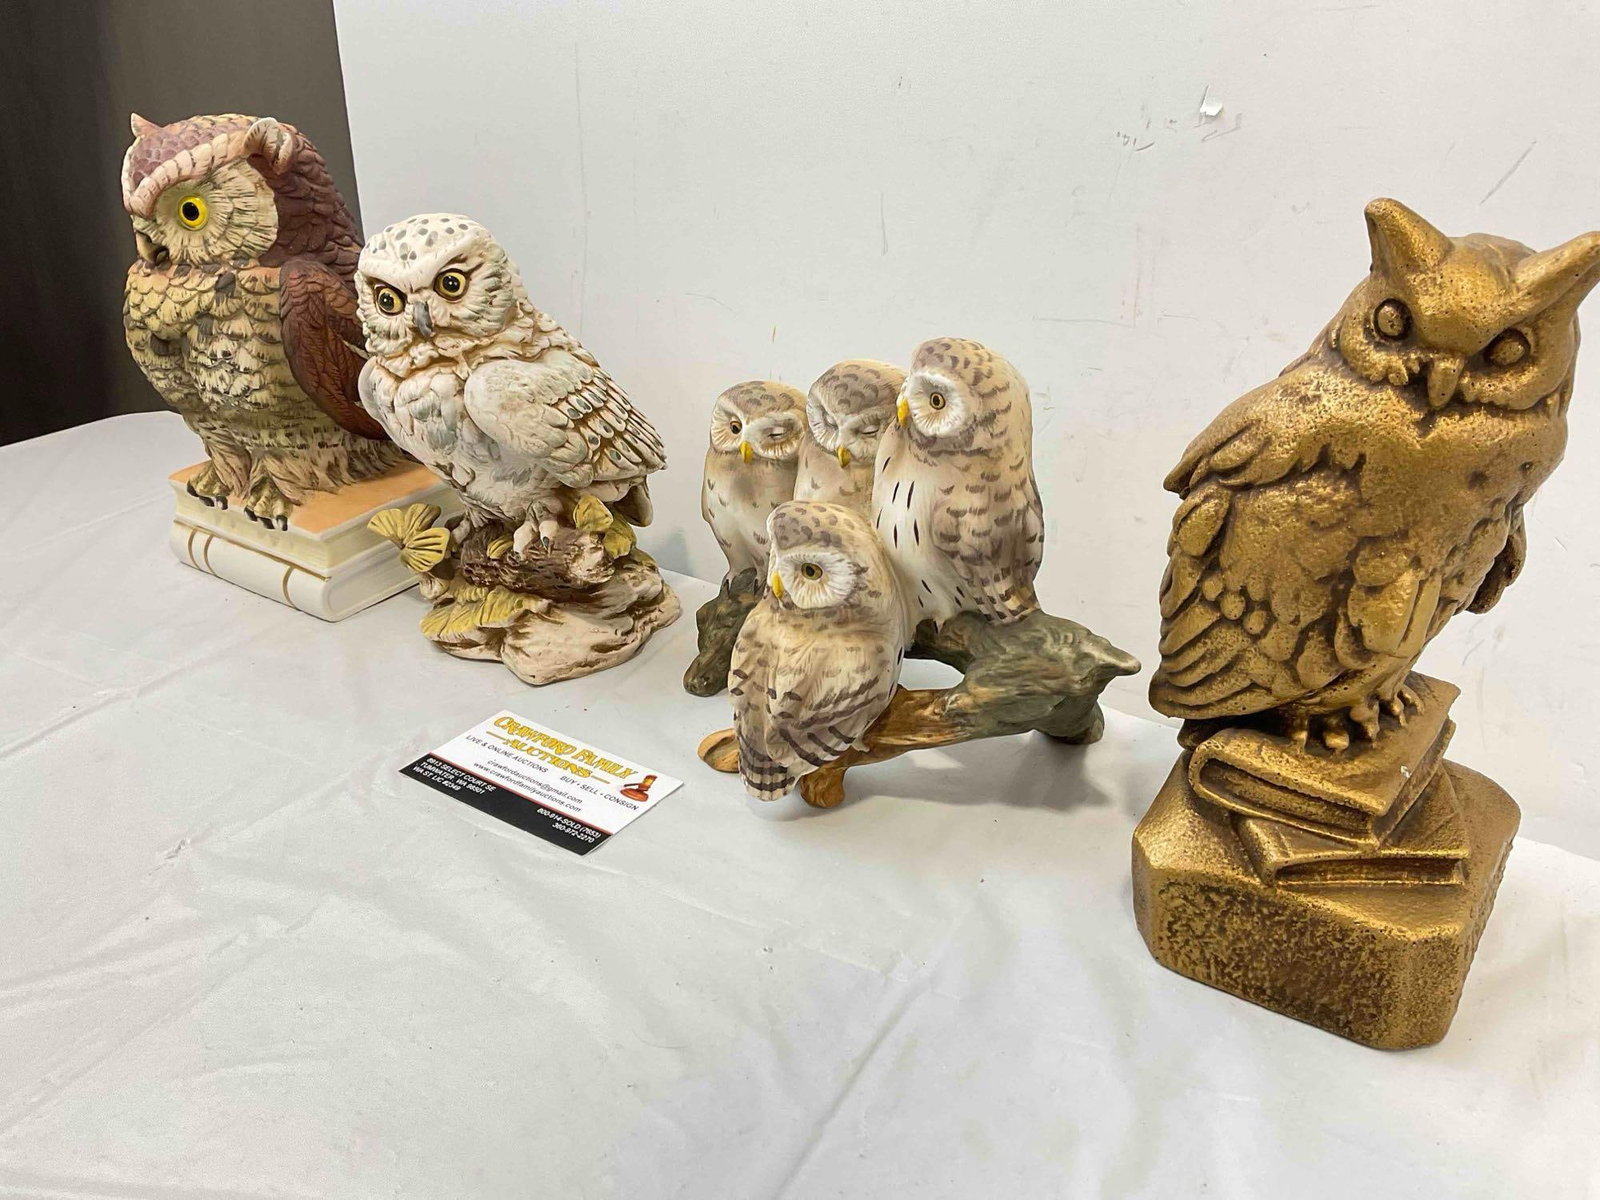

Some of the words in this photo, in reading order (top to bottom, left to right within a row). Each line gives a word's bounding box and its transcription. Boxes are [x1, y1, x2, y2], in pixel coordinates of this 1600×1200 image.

[494, 716, 577, 755] CRAWFORD
[441, 763, 465, 777] SELECT
[463, 774, 487, 788] COURT
[485, 785, 497, 793] SE
[455, 779, 467, 787] WA
[466, 734, 482, 745] LIVE
[487, 744, 514, 760] ONLINE
[512, 753, 549, 774] AUCTIONS
[560, 775, 577, 786] BUY
[580, 784, 598, 795] SELL
[603, 793, 640, 811] CONSIGN
[473, 762, 582, 813] www.crawfordfamilyauctions.com
[487, 760, 583, 804] crawfordauctions@gmail.com
